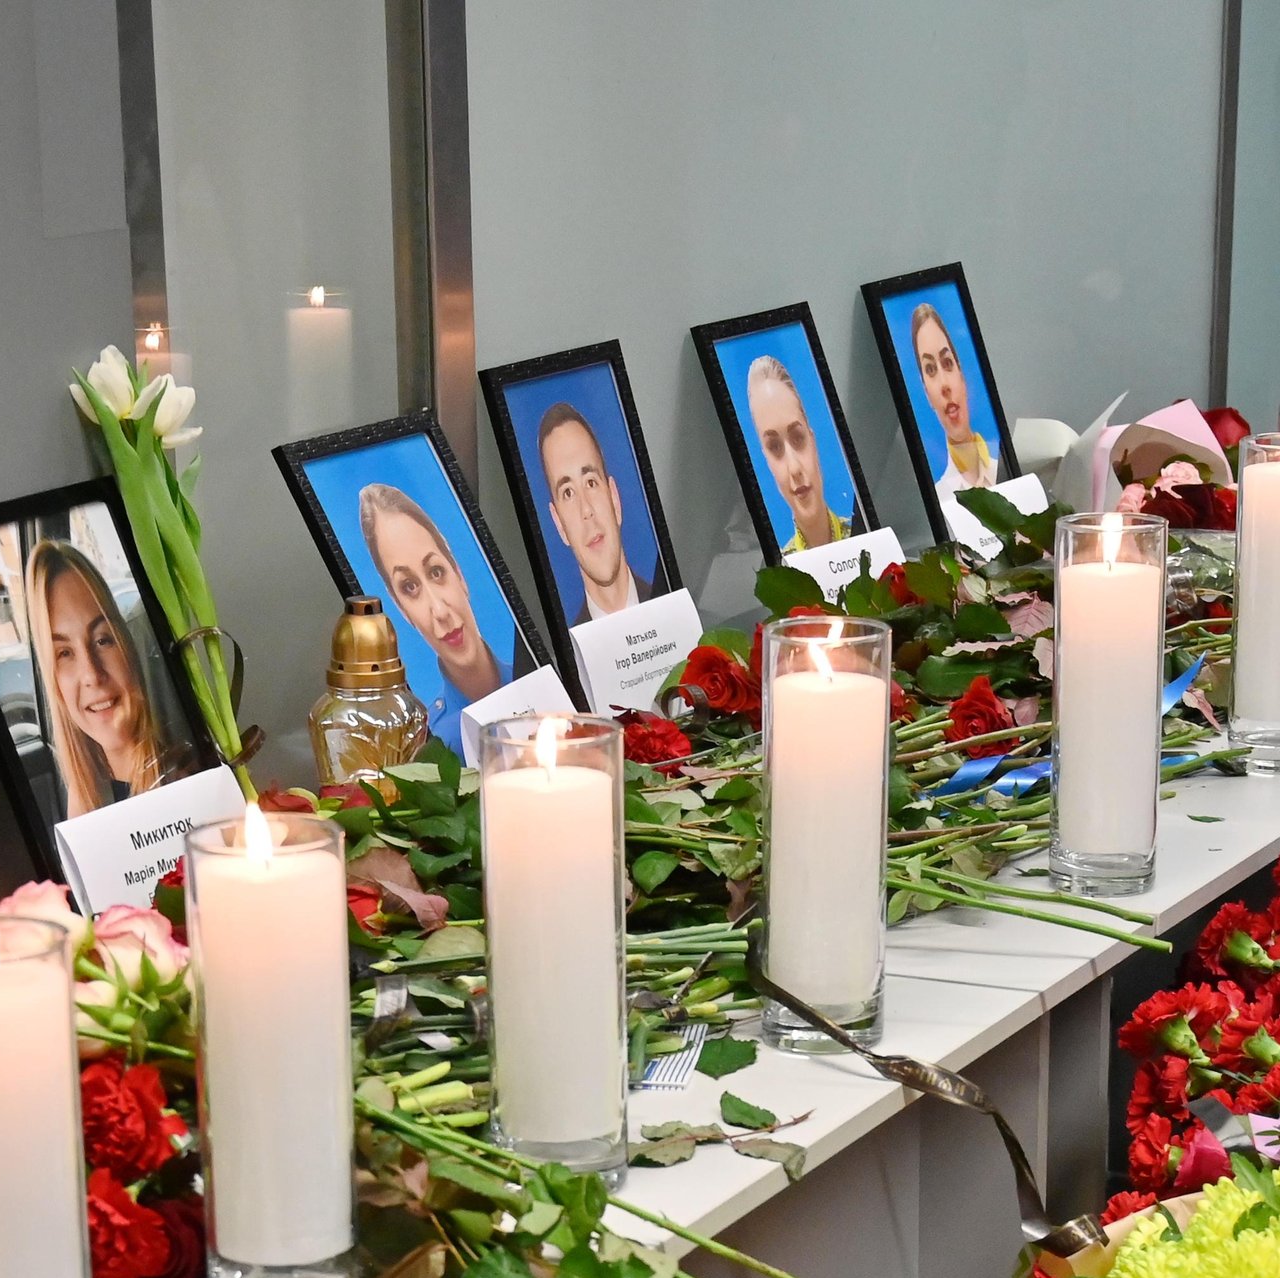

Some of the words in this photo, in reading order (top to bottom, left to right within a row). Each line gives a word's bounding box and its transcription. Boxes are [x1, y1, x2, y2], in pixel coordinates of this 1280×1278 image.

[625, 629, 658, 646] Матьков
[615, 657, 631, 670] Ігор
[631, 641, 677, 665] Валерійович
[130, 817, 195, 850] Микитюк
[124, 865, 156, 886] Марія
[156, 856, 179, 874] Мих
